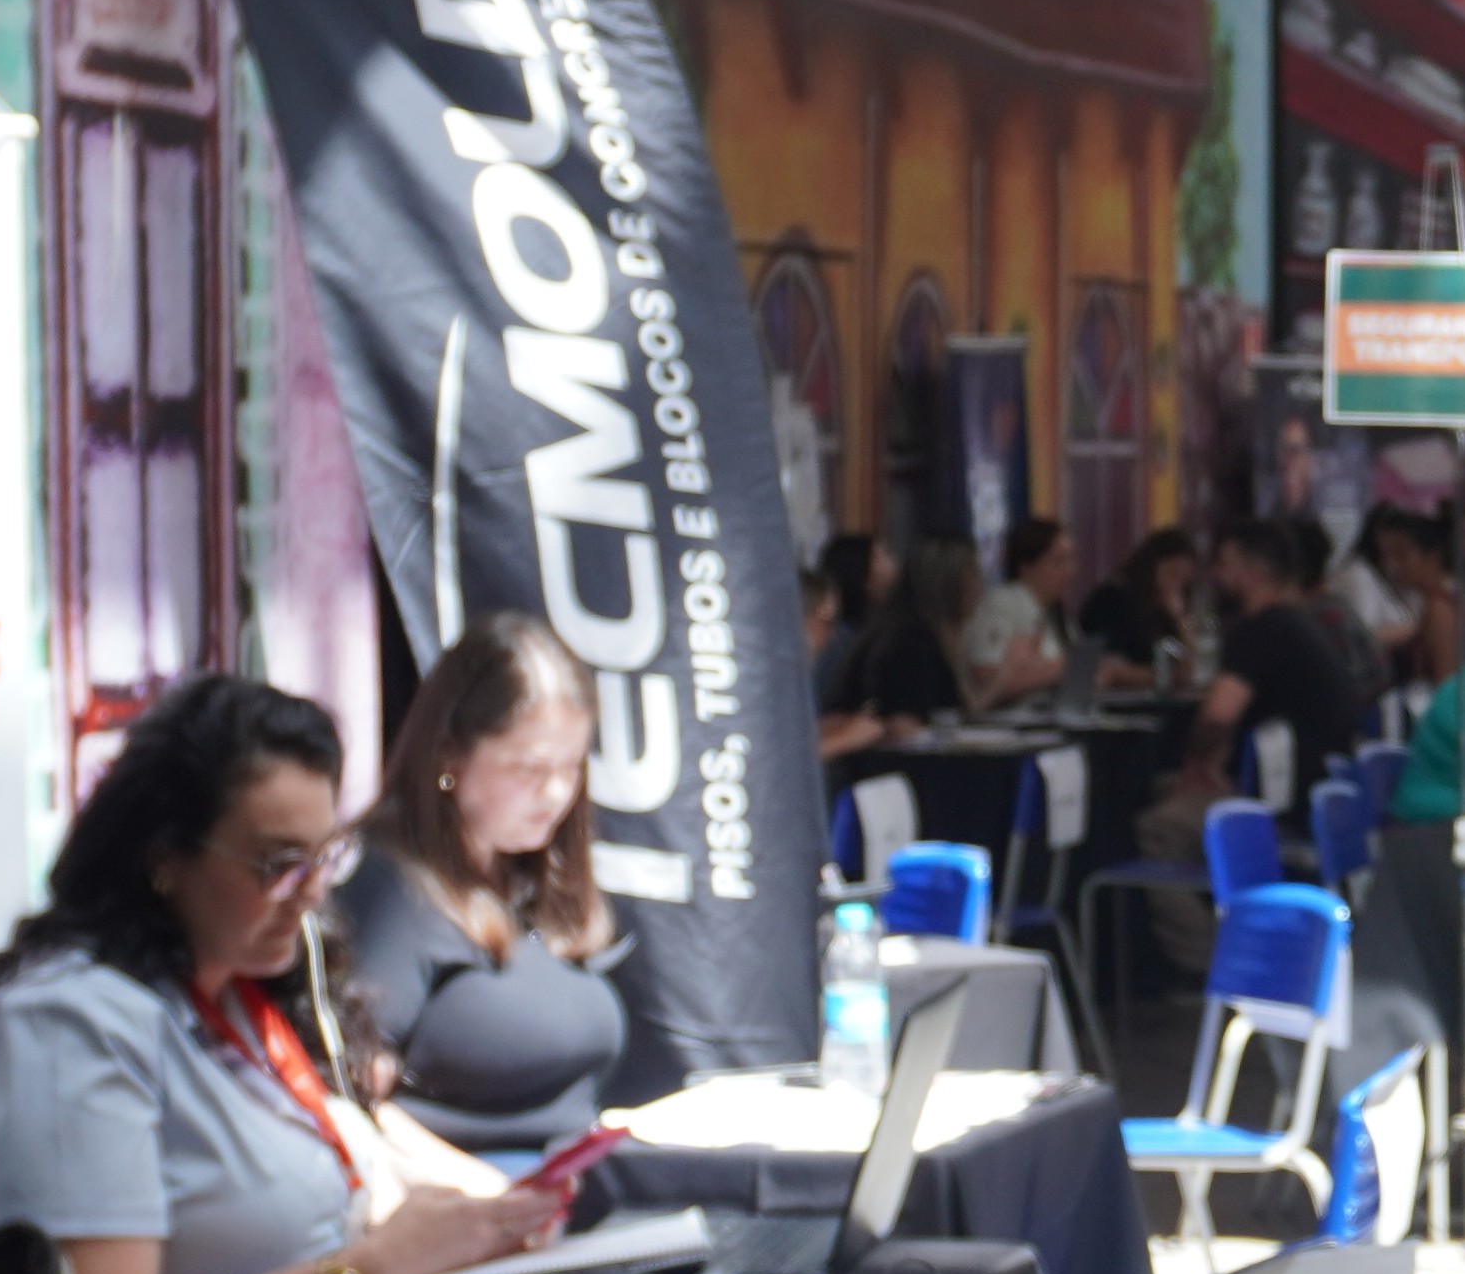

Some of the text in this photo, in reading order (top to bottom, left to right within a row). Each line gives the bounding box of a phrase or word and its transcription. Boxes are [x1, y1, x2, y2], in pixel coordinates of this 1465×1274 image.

[607, 208, 666, 281] DE
[630, 287, 713, 494] BLOCOS
[671, 503, 719, 539] E
[679, 549, 738, 723] TUBOS
[699, 731, 754, 901] PISOS,
